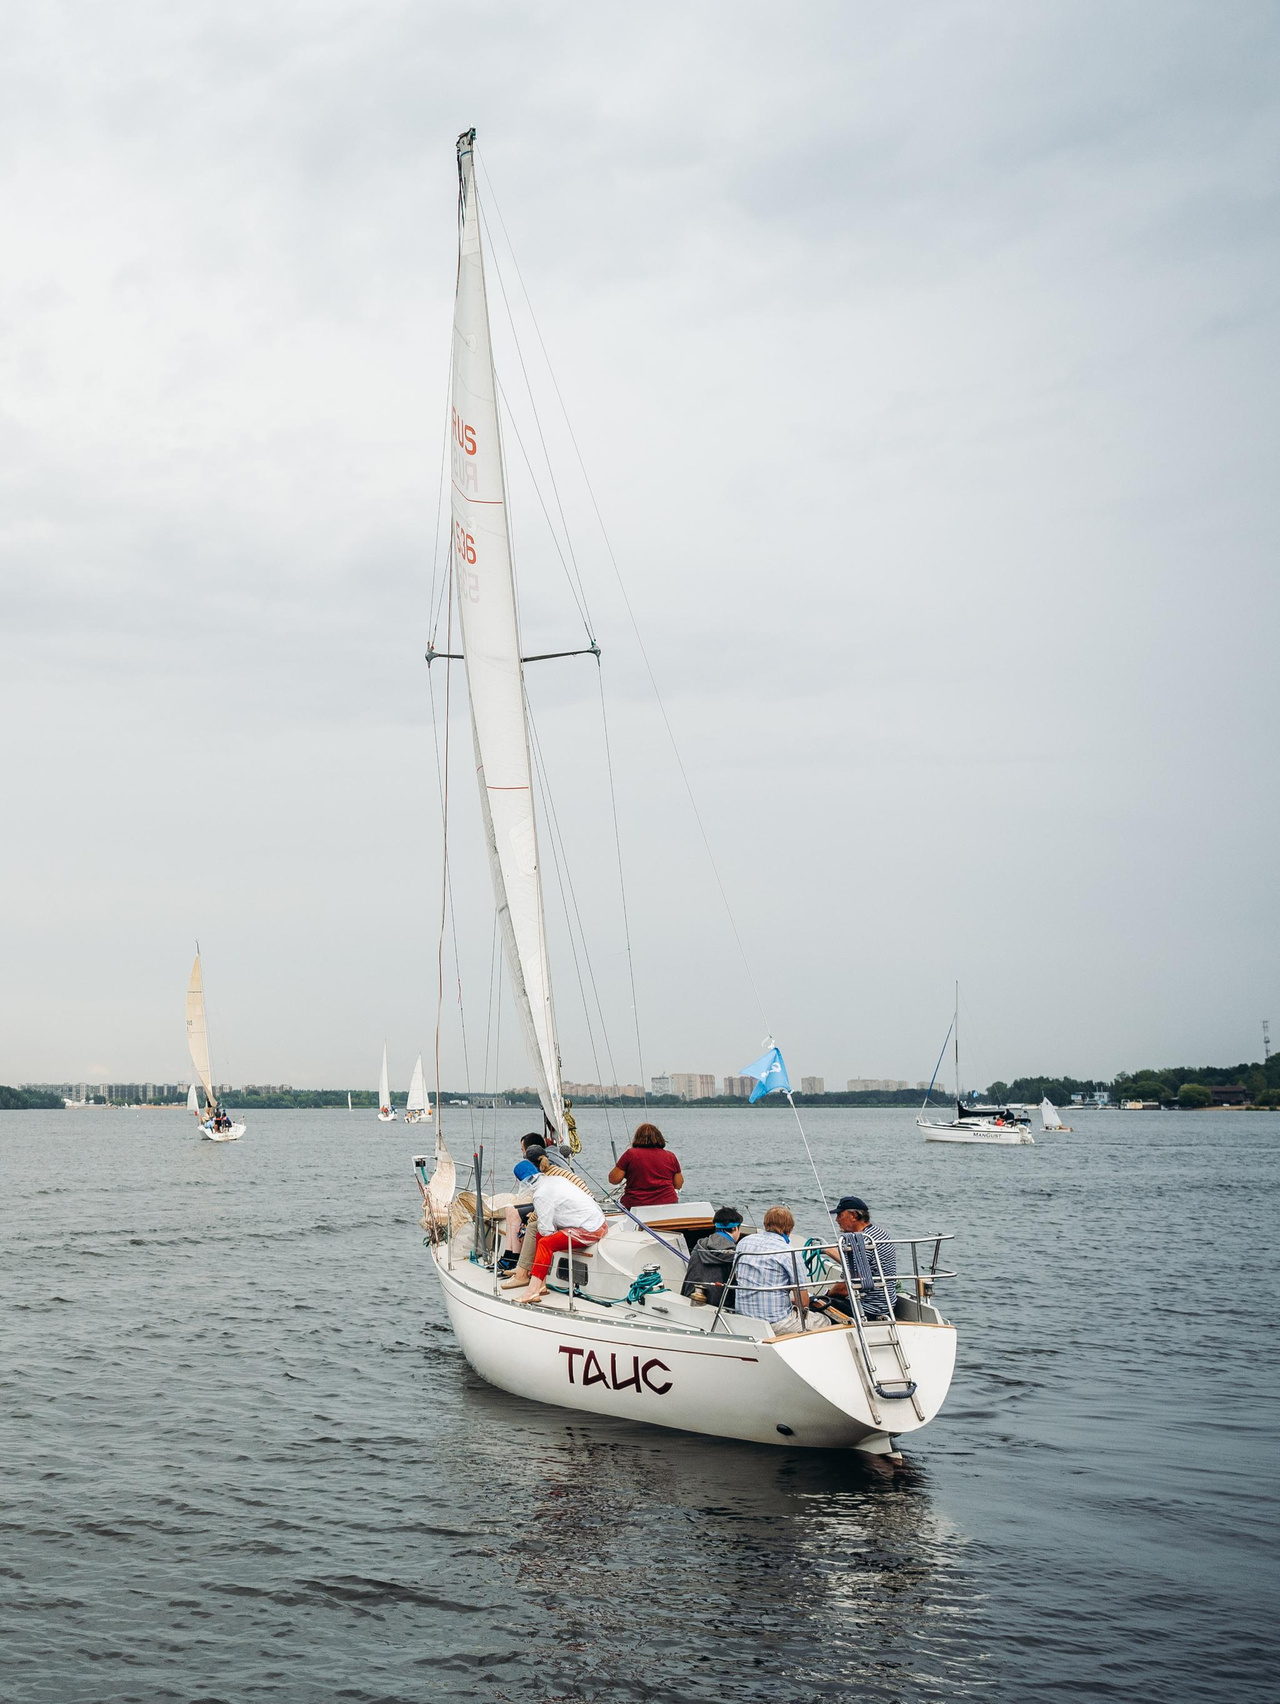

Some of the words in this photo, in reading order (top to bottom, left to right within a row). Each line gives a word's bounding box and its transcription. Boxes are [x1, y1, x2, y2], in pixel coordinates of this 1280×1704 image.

[452, 406, 477, 455] RUS
[456, 520, 477, 565] 536
[558, 1345, 674, 1396] ТАИС
